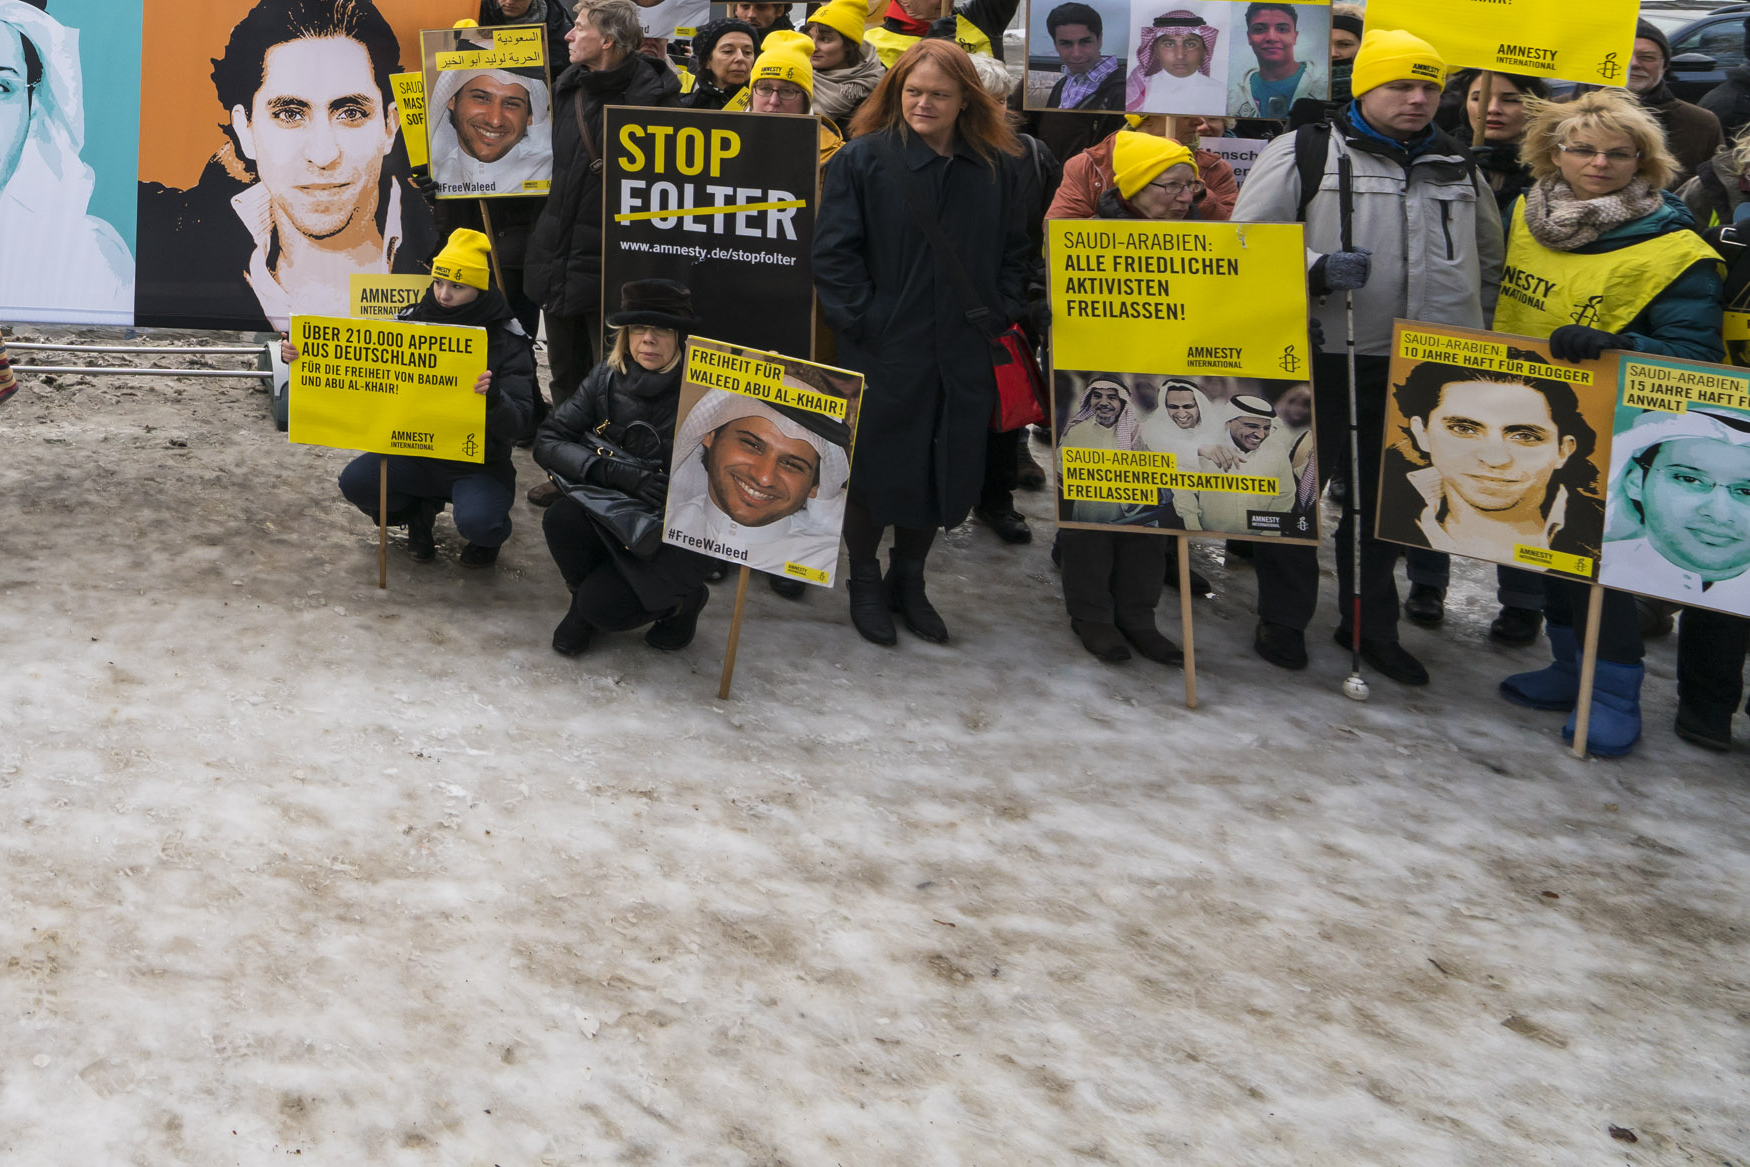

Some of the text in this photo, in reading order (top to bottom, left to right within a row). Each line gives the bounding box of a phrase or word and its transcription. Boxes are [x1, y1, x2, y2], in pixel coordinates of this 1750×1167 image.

[1496, 56, 1556, 70] INTERNATIONAL
[1497, 44, 1558, 62] AMNESTY
[1413, 64, 1440, 75] AMNESTY
[618, 124, 741, 177] STOP
[437, 182, 495, 192] #FreeWaleed
[615, 179, 806, 241] FOLTER
[1064, 232, 1212, 252] SAUDI-ARABIEN:
[620, 241, 796, 266] www.amnesty.de/stopfolter
[1065, 254, 1238, 276] ALLE FRIEDLICHEN
[360, 288, 420, 304] AMNESTY
[1066, 277, 1169, 296] AKTIVISTEN
[1067, 300, 1185, 321] FREILASSEN!
[302, 322, 473, 354] ÜBER 210.000 APPELLE
[1404, 333, 1503, 357] SAUDI-ARABIEN:
[302, 342, 437, 369] AUS DEUTSCHLAND
[1187, 346, 1242, 359] AMNESTY
[692, 349, 781, 381] FREIHEIT FÜR
[1187, 359, 1242, 368] INTERNATIONAL
[1404, 346, 1590, 383] 10 JAHRE HAFT FÜR BLOGGER
[302, 361, 458, 387] FÜR DIE FREIHEIT VON BADAWI
[302, 376, 399, 394] UND ABU AL-KHAIR!
[689, 368, 844, 415] WALEED ABU AL-KHAIR!
[391, 431, 434, 442] AMNESTY
[391, 442, 434, 450] INTERNATIONAL
[1066, 450, 1174, 469] SAUDI-ARABIEN:
[1067, 468, 1276, 493] MENSCHENRECHTSAKTIVISTEN
[1068, 484, 1154, 503] FREILASSEN!
[668, 528, 748, 561] #FreeWaleed
